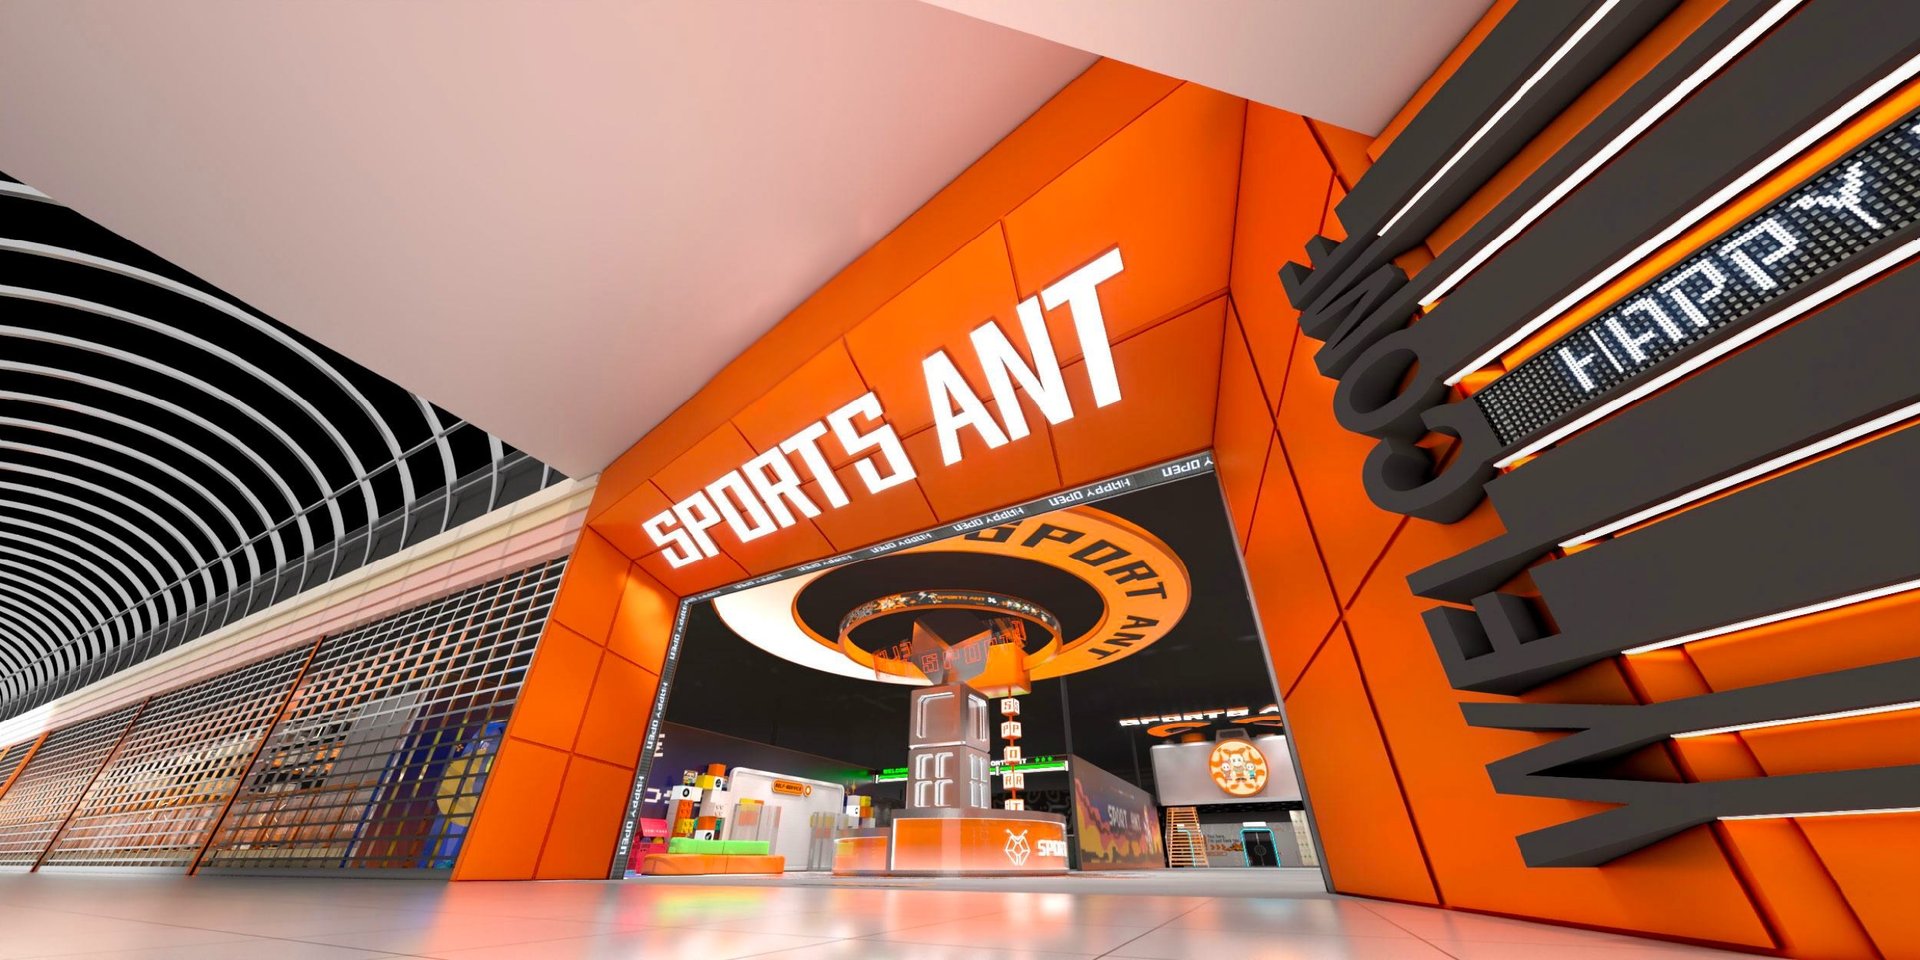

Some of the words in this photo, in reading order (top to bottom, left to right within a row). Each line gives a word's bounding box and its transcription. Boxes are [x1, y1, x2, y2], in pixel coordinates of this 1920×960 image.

[1559, 162, 1883, 393] HAPPY
[641, 391, 918, 569] SPORTS
[921, 247, 1124, 467] ANT
[1161, 459, 1201, 477] OPEN
[1049, 491, 1083, 506] OPEN
[1087, 478, 1131, 498] HAPPY
[953, 519, 983, 532] OPEN
[986, 507, 1024, 524] HAPPY
[870, 542, 897, 554] OPEN
[964, 520, 1168, 600] SPORT
[1088, 615, 1160, 660] ANT
[657, 682, 669, 719] HAPPY
[645, 720, 659, 750] OPEN
[631, 775, 645, 818] HAPPY
[619, 821, 634, 855] OPEN
